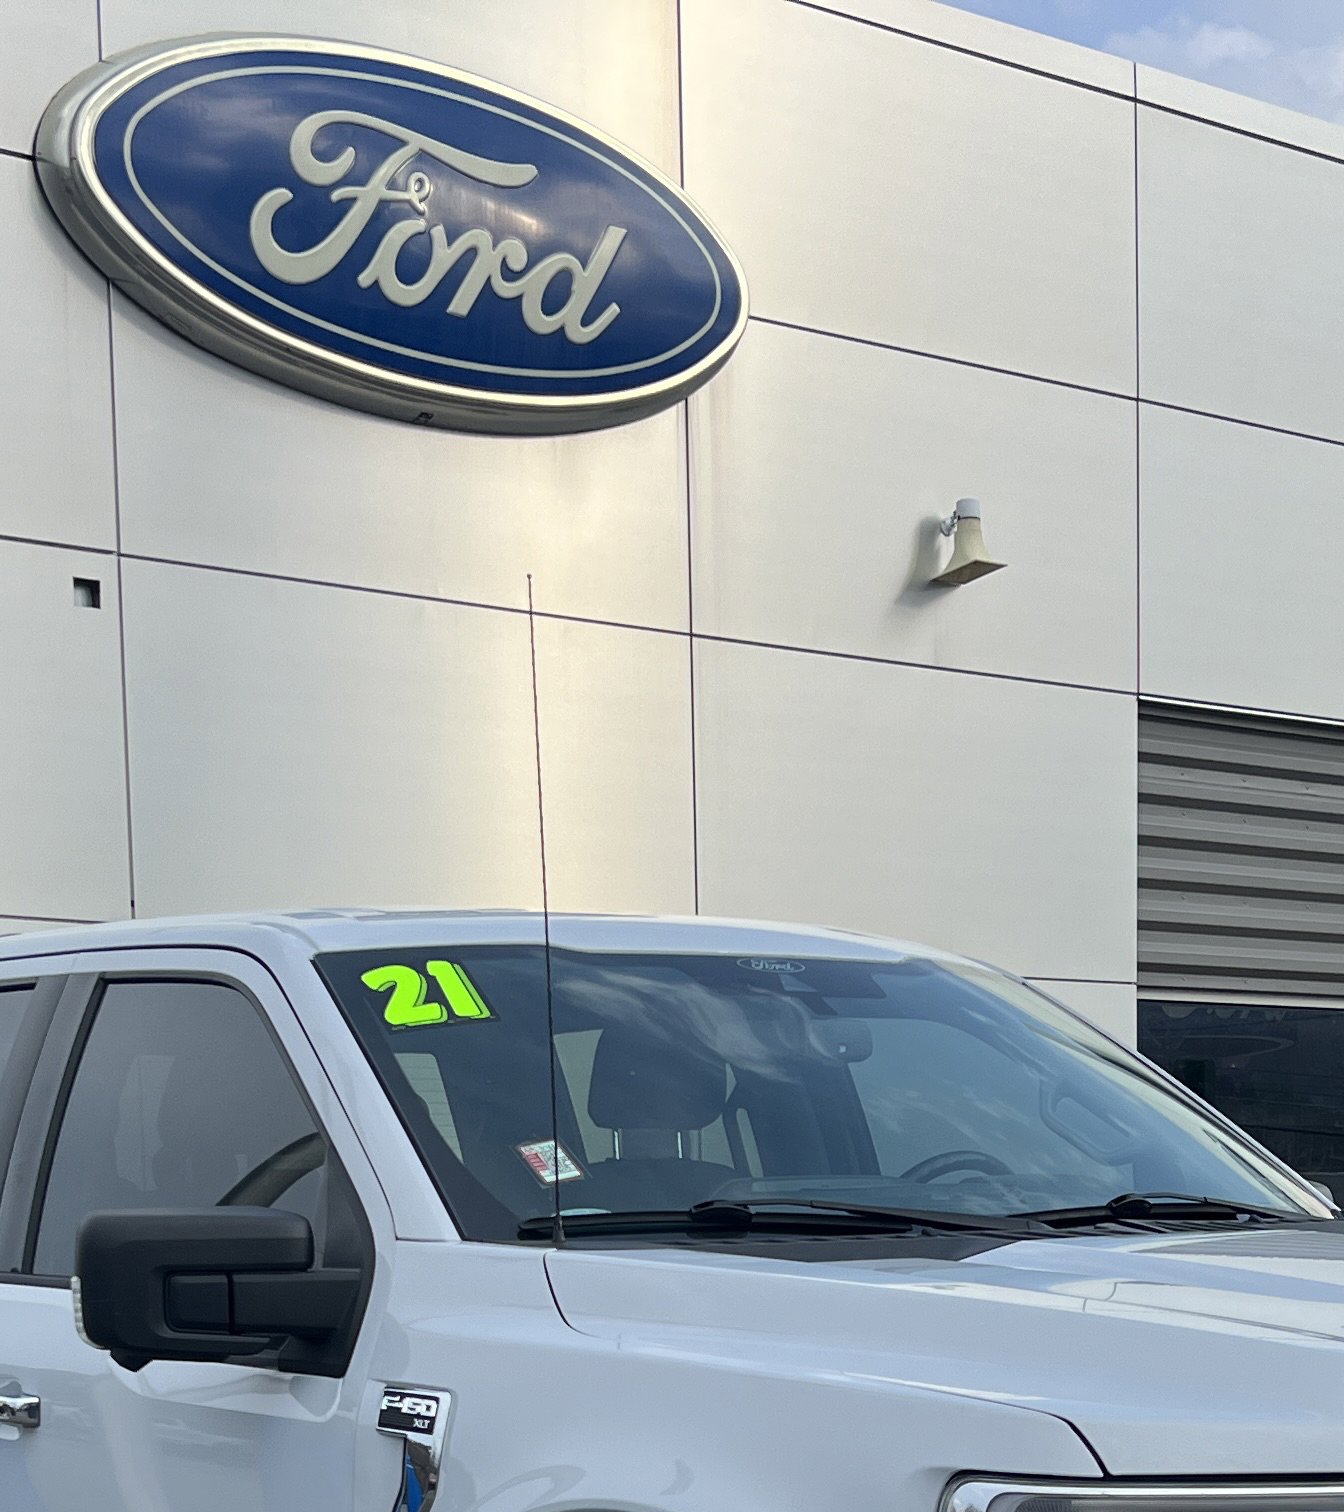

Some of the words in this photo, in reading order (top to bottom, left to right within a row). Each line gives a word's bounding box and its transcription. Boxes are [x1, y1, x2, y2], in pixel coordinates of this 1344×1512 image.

[249, 109, 627, 345] Ford
[360, 959, 491, 1027] 21
[413, 1418, 431, 1429] XLT
